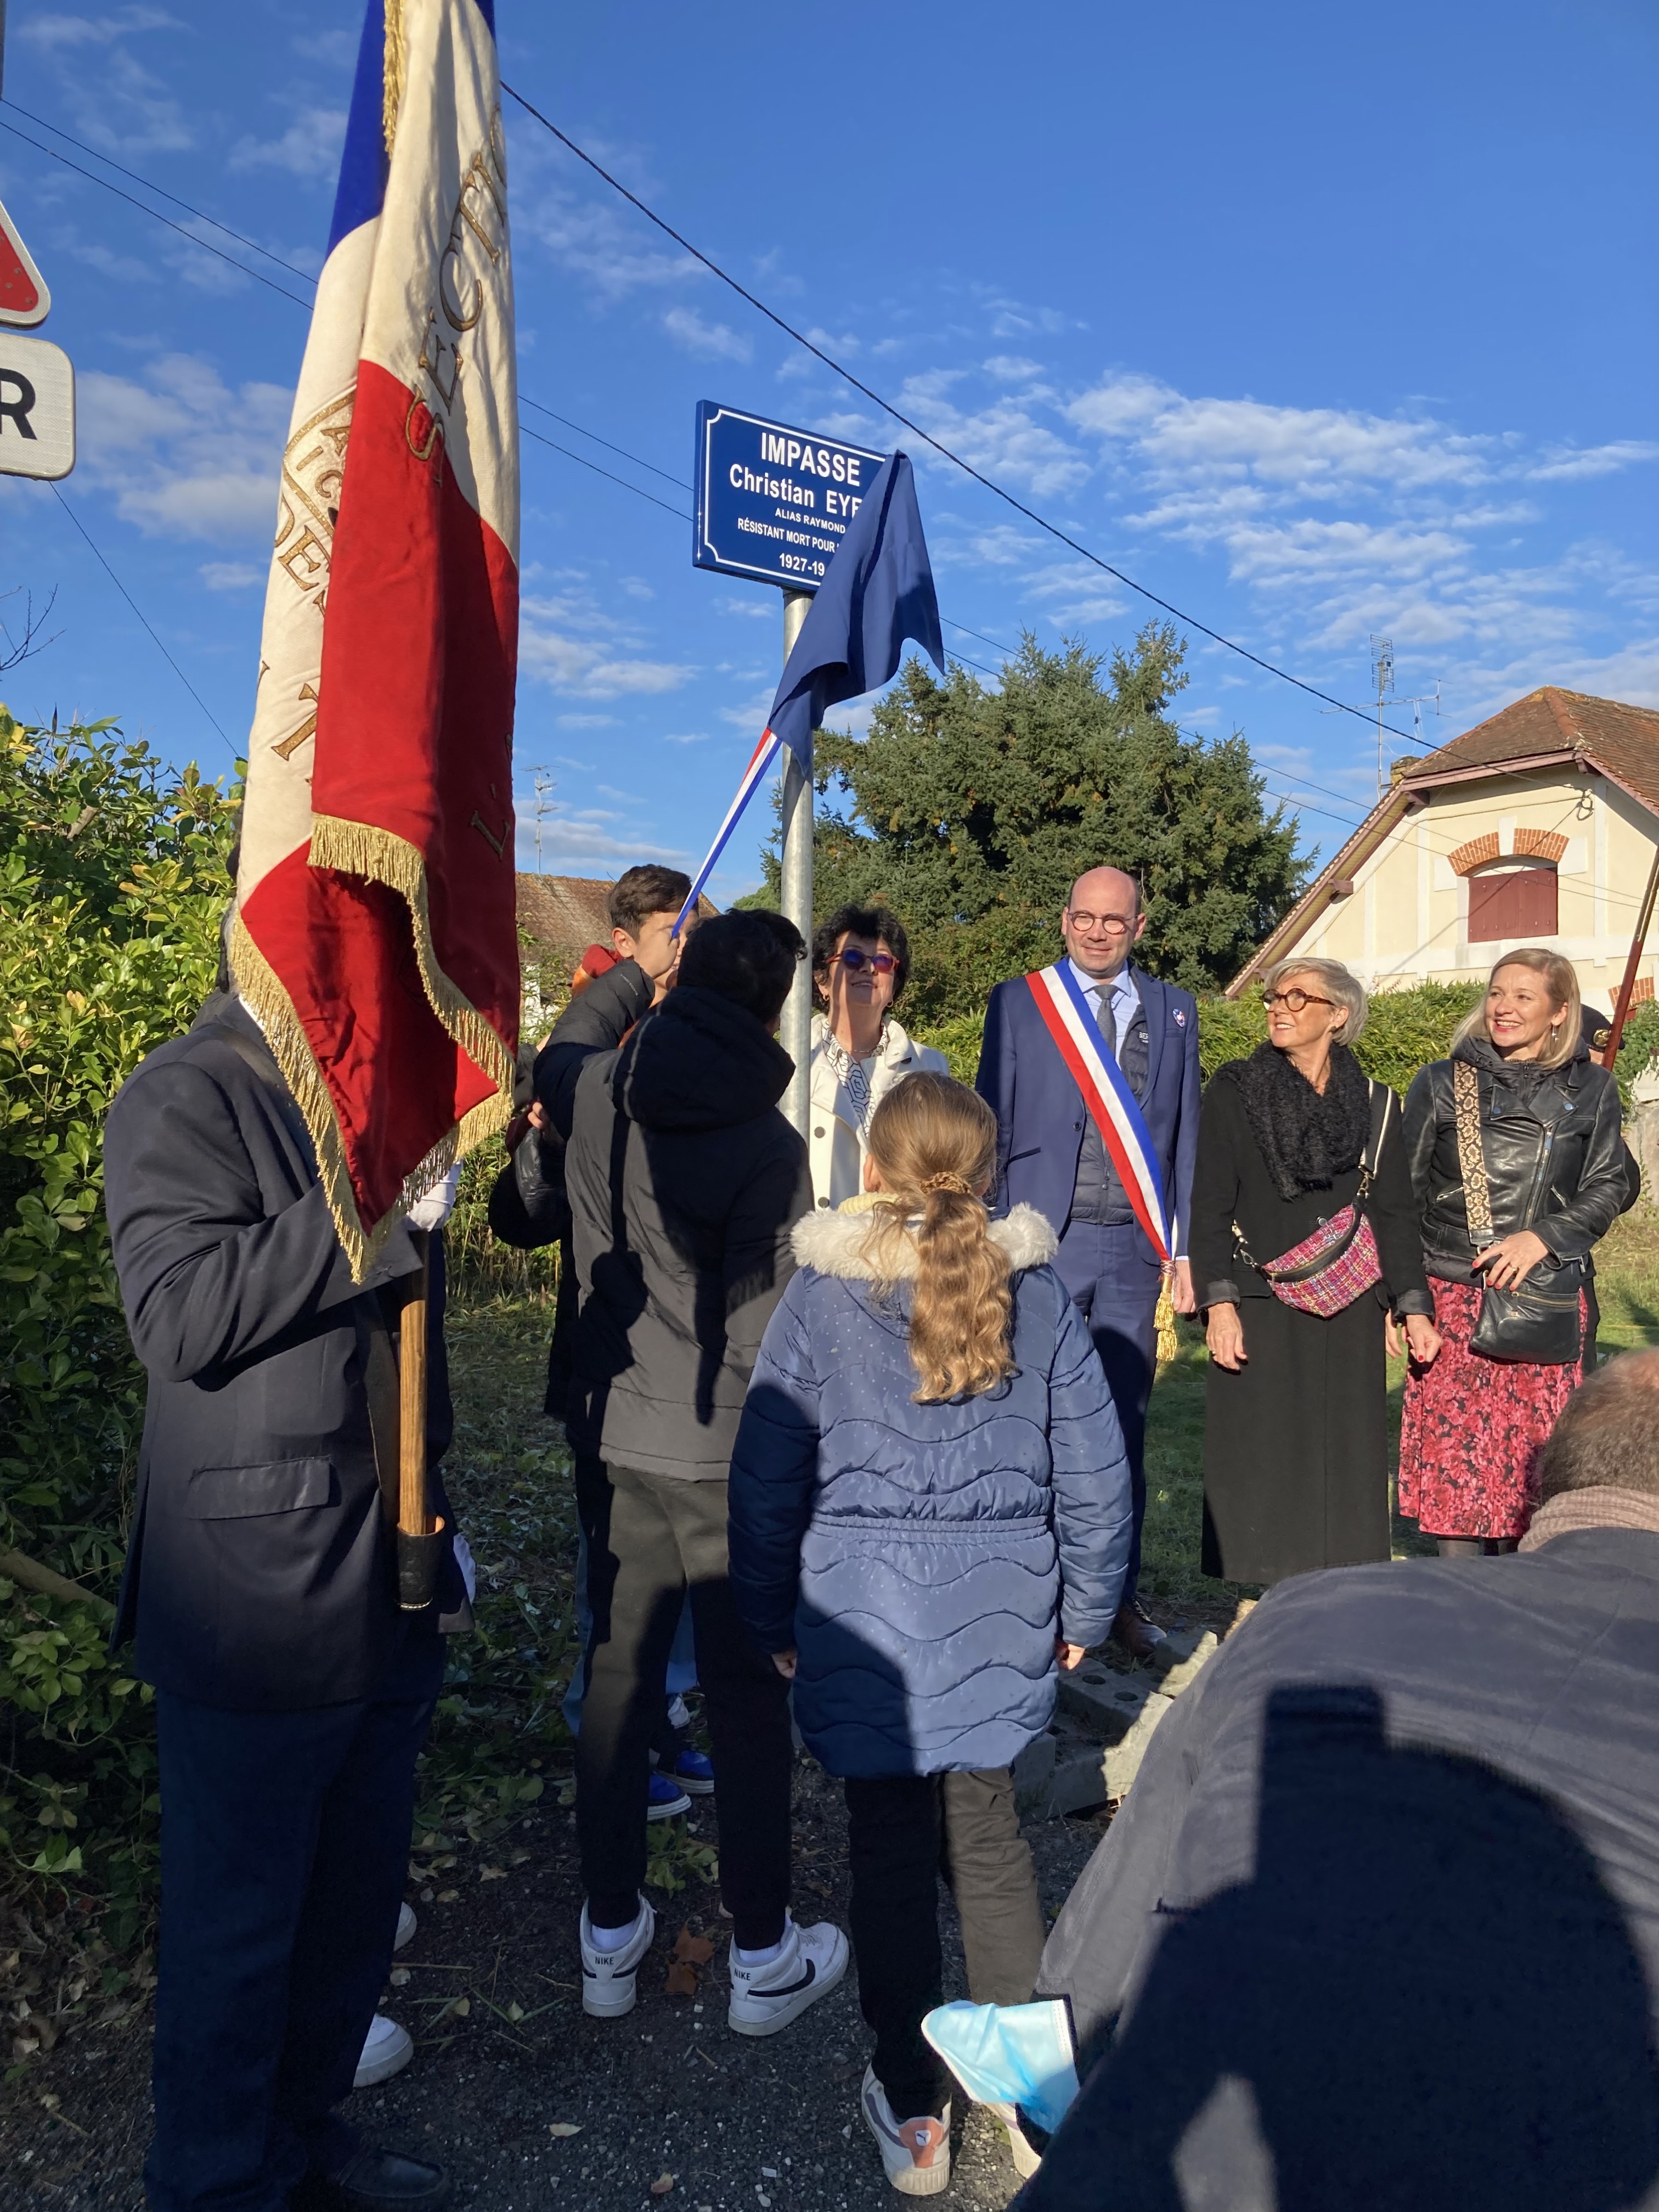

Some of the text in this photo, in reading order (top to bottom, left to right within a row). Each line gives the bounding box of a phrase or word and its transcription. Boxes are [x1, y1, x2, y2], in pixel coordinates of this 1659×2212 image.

[761, 432, 860, 487] IMPASSE
[730, 464, 814, 508] Christian
[775, 508, 846, 534] ALIAS RAYMOND
[738, 517, 835, 553] RÉSISTANT MORT POUR
[779, 553, 825, 576] 1927-19
[595, 1956, 614, 1965] NIKE
[734, 1968, 751, 1981] NIKE
